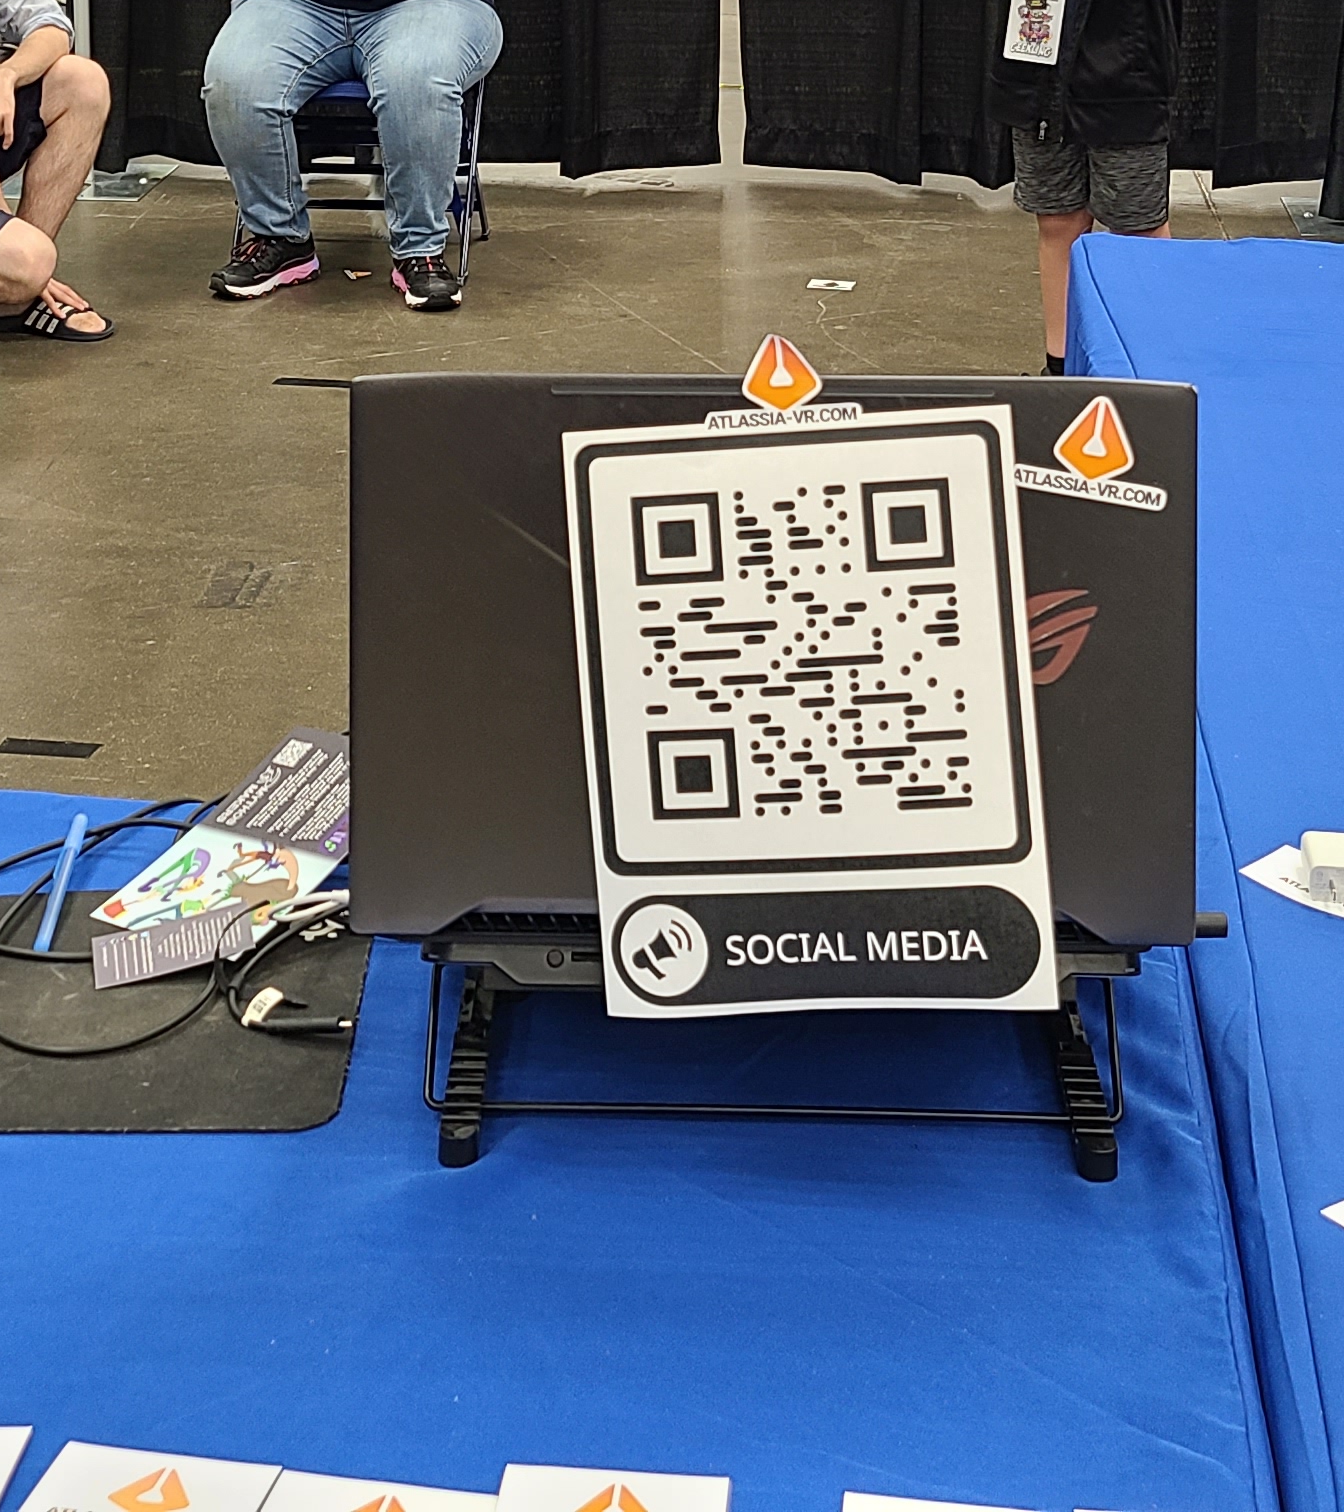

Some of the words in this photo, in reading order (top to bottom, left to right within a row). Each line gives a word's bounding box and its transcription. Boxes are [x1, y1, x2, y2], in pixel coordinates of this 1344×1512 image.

[707, 407, 858, 431] ATLASSIA-VR.COM
[1014, 467, 1162, 508] ATLASSIA-VR.COM
[725, 931, 857, 967] SOCIAL
[866, 929, 989, 962] MEDIA
